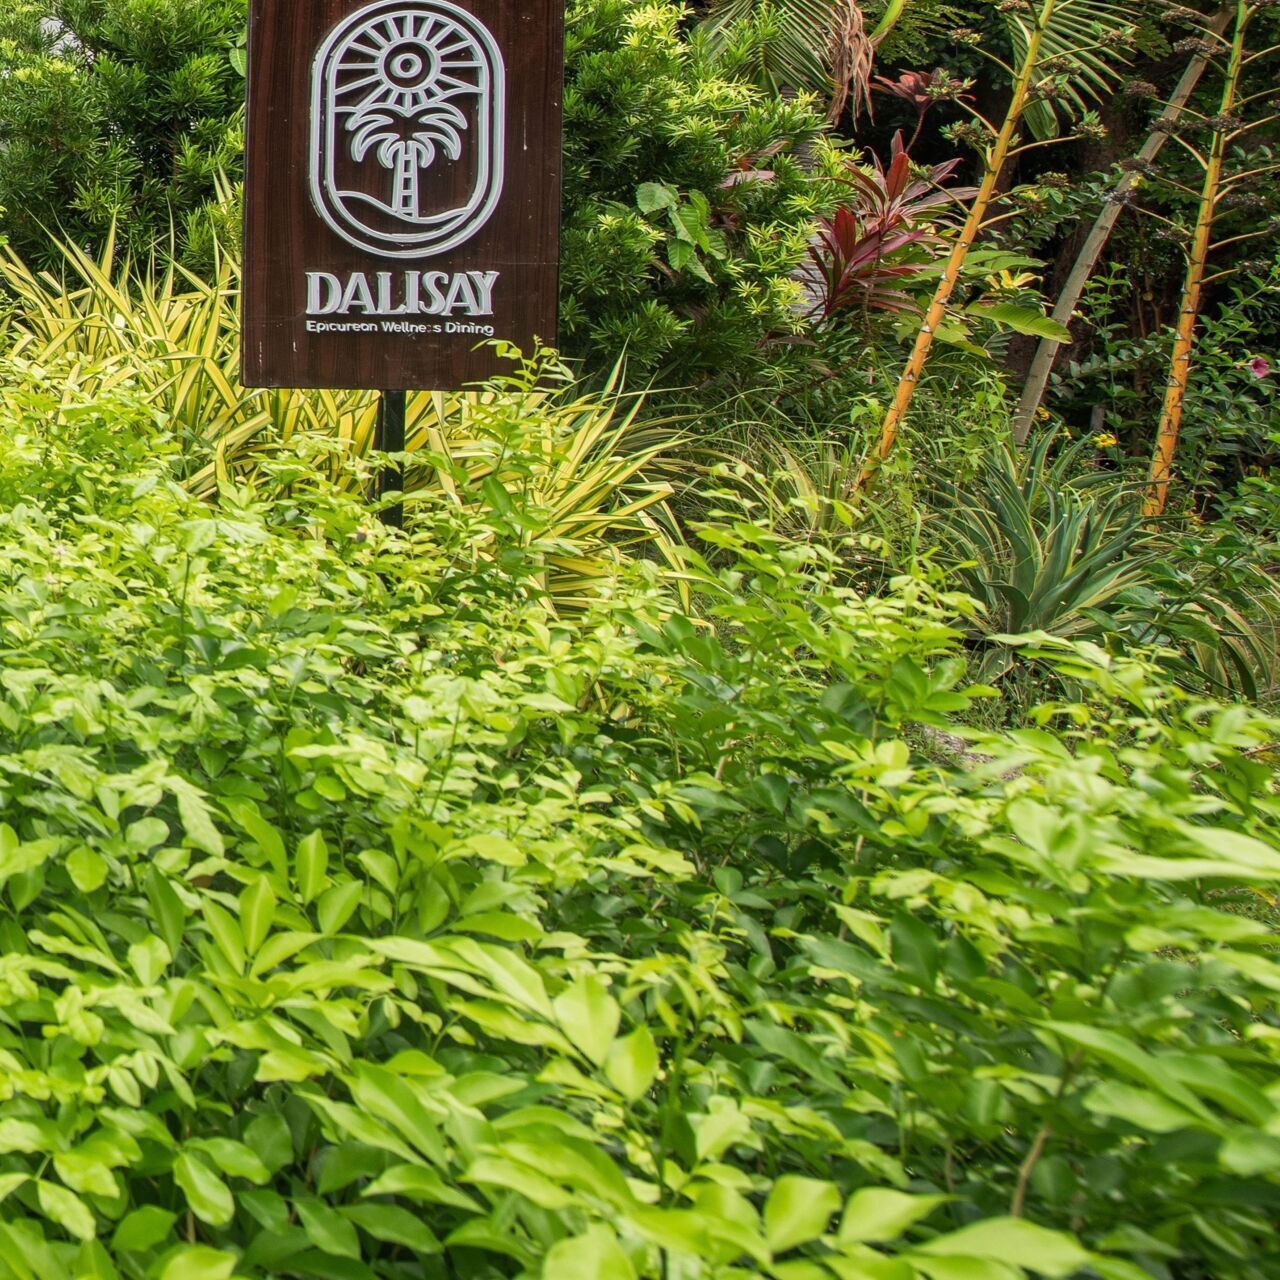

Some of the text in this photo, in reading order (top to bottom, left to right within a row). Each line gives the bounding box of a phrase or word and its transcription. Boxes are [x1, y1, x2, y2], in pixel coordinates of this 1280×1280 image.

[305, 271, 500, 315] DALISAY
[306, 320, 378, 333] Epicurean
[445, 322, 495, 336] Dining
